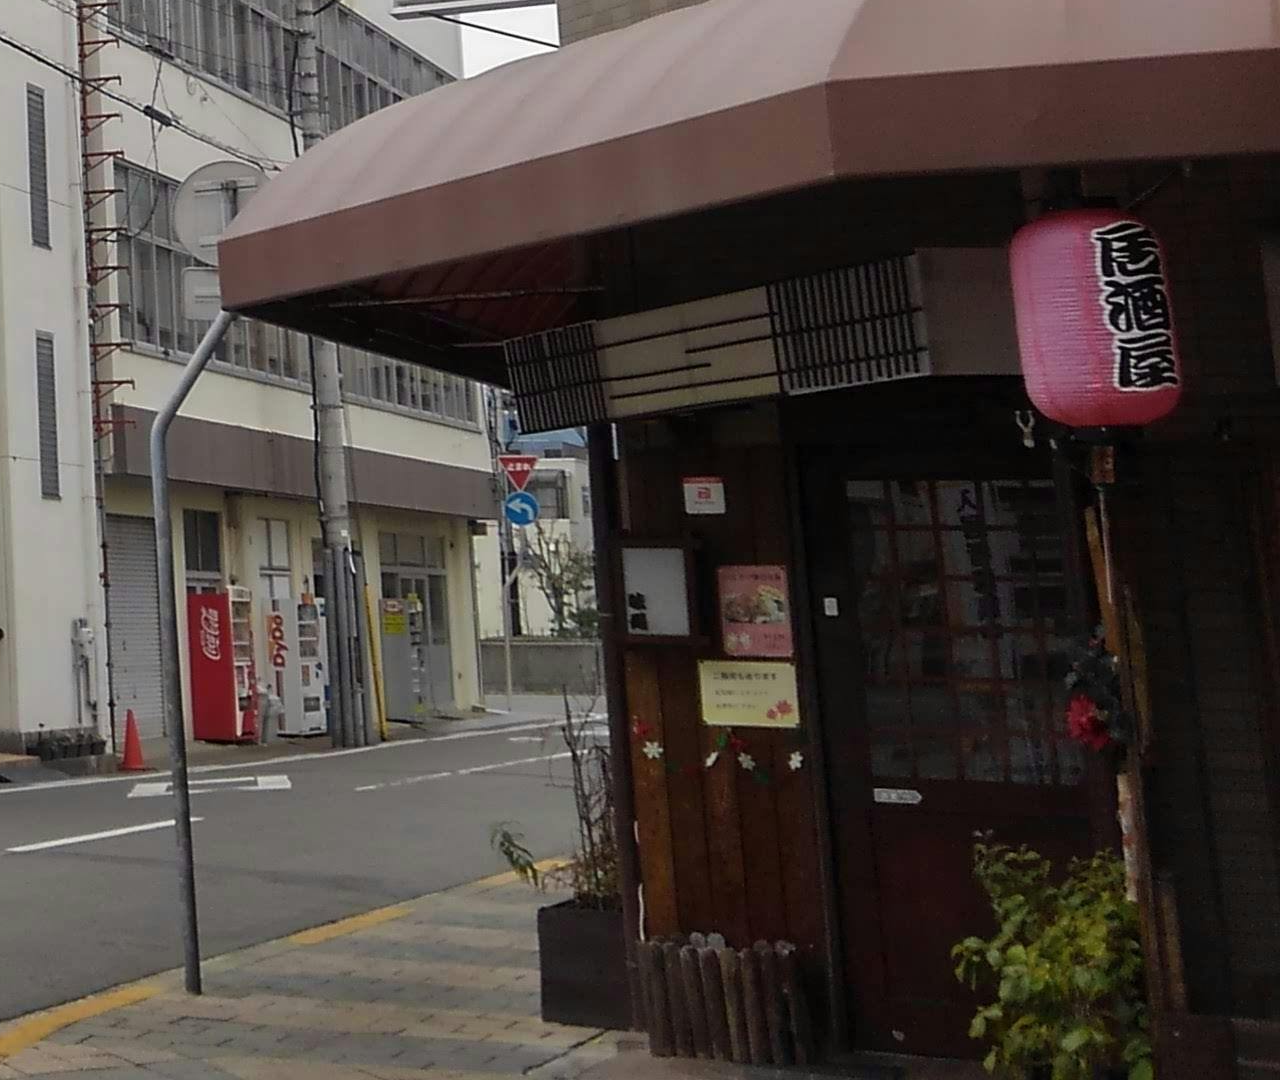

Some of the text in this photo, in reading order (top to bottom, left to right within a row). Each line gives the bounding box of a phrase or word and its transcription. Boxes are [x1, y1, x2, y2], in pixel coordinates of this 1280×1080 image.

[1090, 220, 1182, 392] 居酒屋
[271, 614, 289, 668] DyDo
